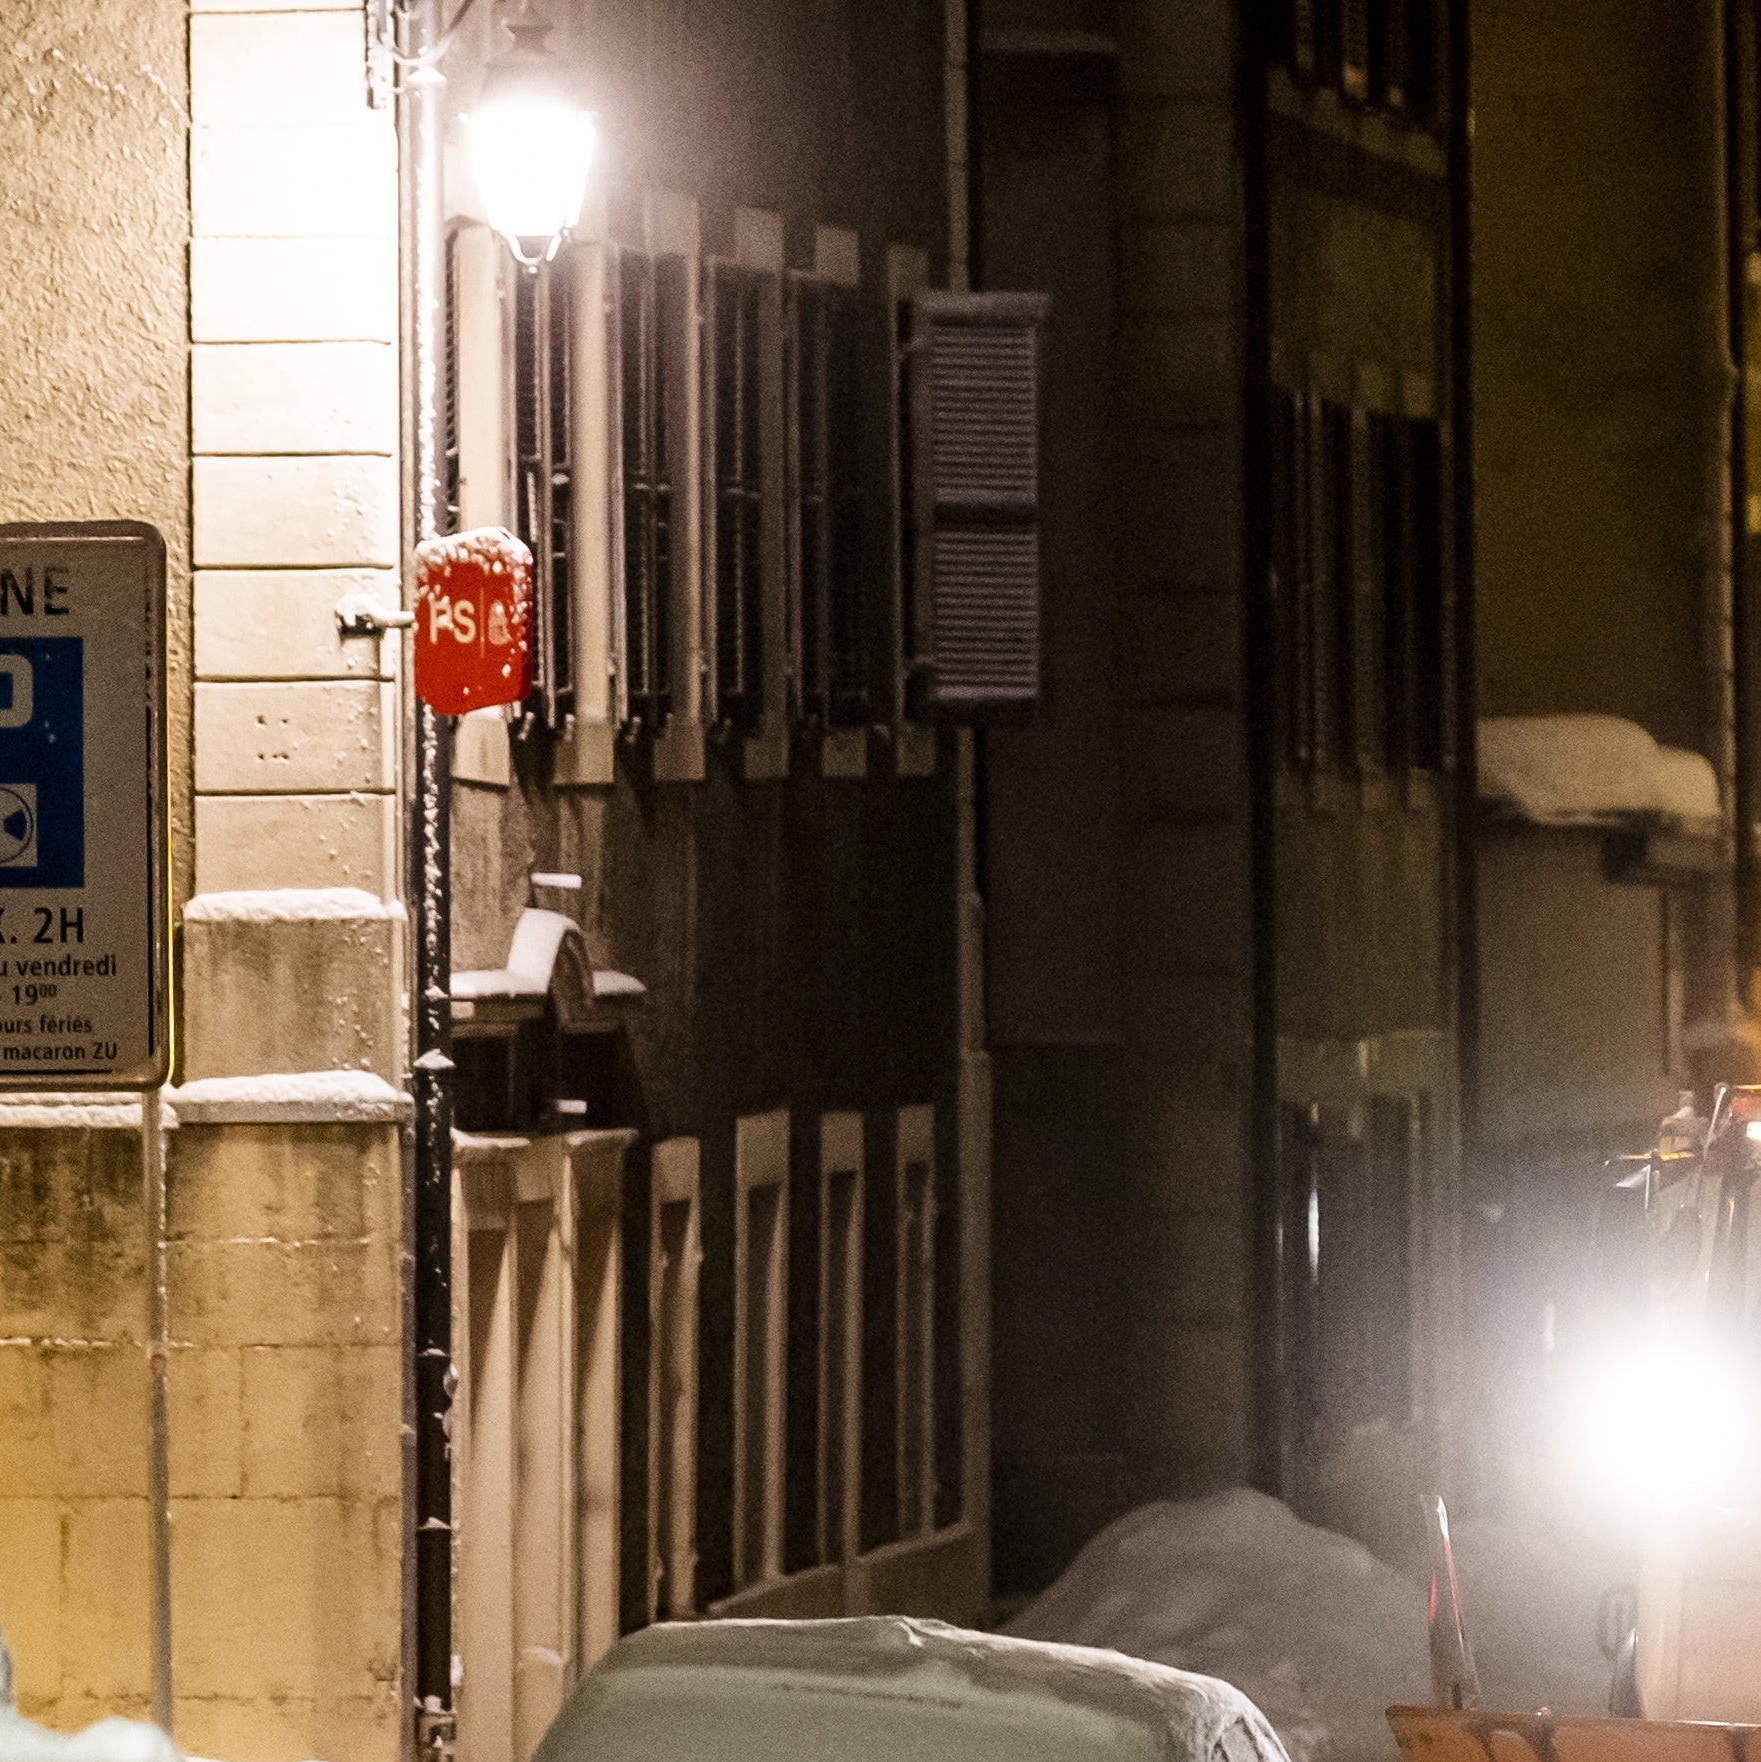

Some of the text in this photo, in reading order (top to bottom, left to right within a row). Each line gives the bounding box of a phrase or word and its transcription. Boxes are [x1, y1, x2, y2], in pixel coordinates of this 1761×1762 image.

[33, 906, 84, 944] 2H
[16, 954, 117, 977] vendredi
[40, 1014, 93, 1034] fériés
[3, 1046, 86, 1061] macaron
[92, 1042, 118, 1061] ZU
